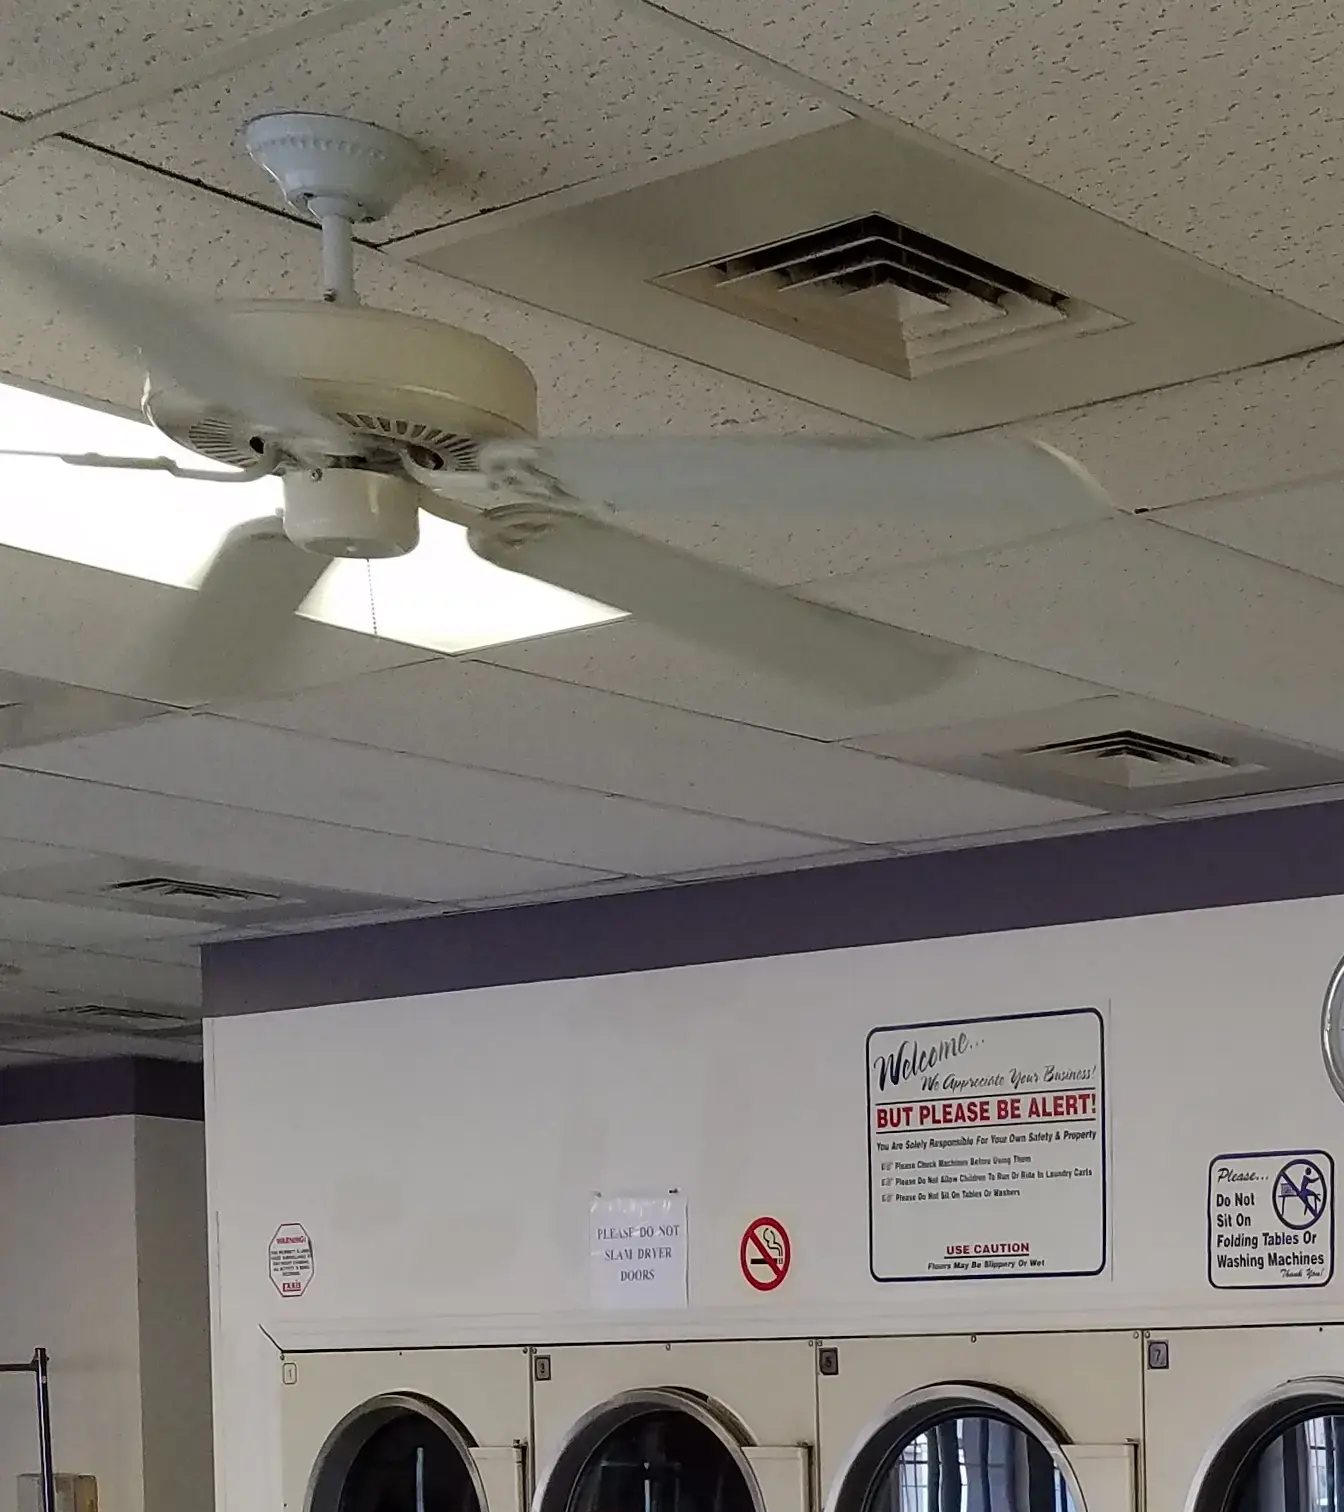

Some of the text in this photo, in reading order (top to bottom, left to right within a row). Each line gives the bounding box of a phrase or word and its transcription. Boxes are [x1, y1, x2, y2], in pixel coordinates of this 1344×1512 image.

[921, 1065, 1096, 1093] We Appreciate Your Business!
[877, 1093, 1096, 1128] BUT PLEASE BE ALERT!
[877, 1130, 1096, 1151] You Are Solely Responsible For Your Own Safety & Property
[1218, 1168, 1268, 1183] Please...
[1217, 1193, 1254, 1207] Do Not
[1217, 1213, 1251, 1227] Sit On
[597, 1225, 680, 1240] PLEASE DO NOT
[1217, 1231, 1316, 1249] Folding Tables Or
[604, 1247, 672, 1261] SLAM DRYER
[947, 1243, 1029, 1255] USE CAUTION
[1217, 1251, 1324, 1269] Washing Machines
[621, 1269, 655, 1281] DOORS
[1280, 1268, 1324, 1279] Thank You!
[1155, 1349, 1161, 1363] 7
